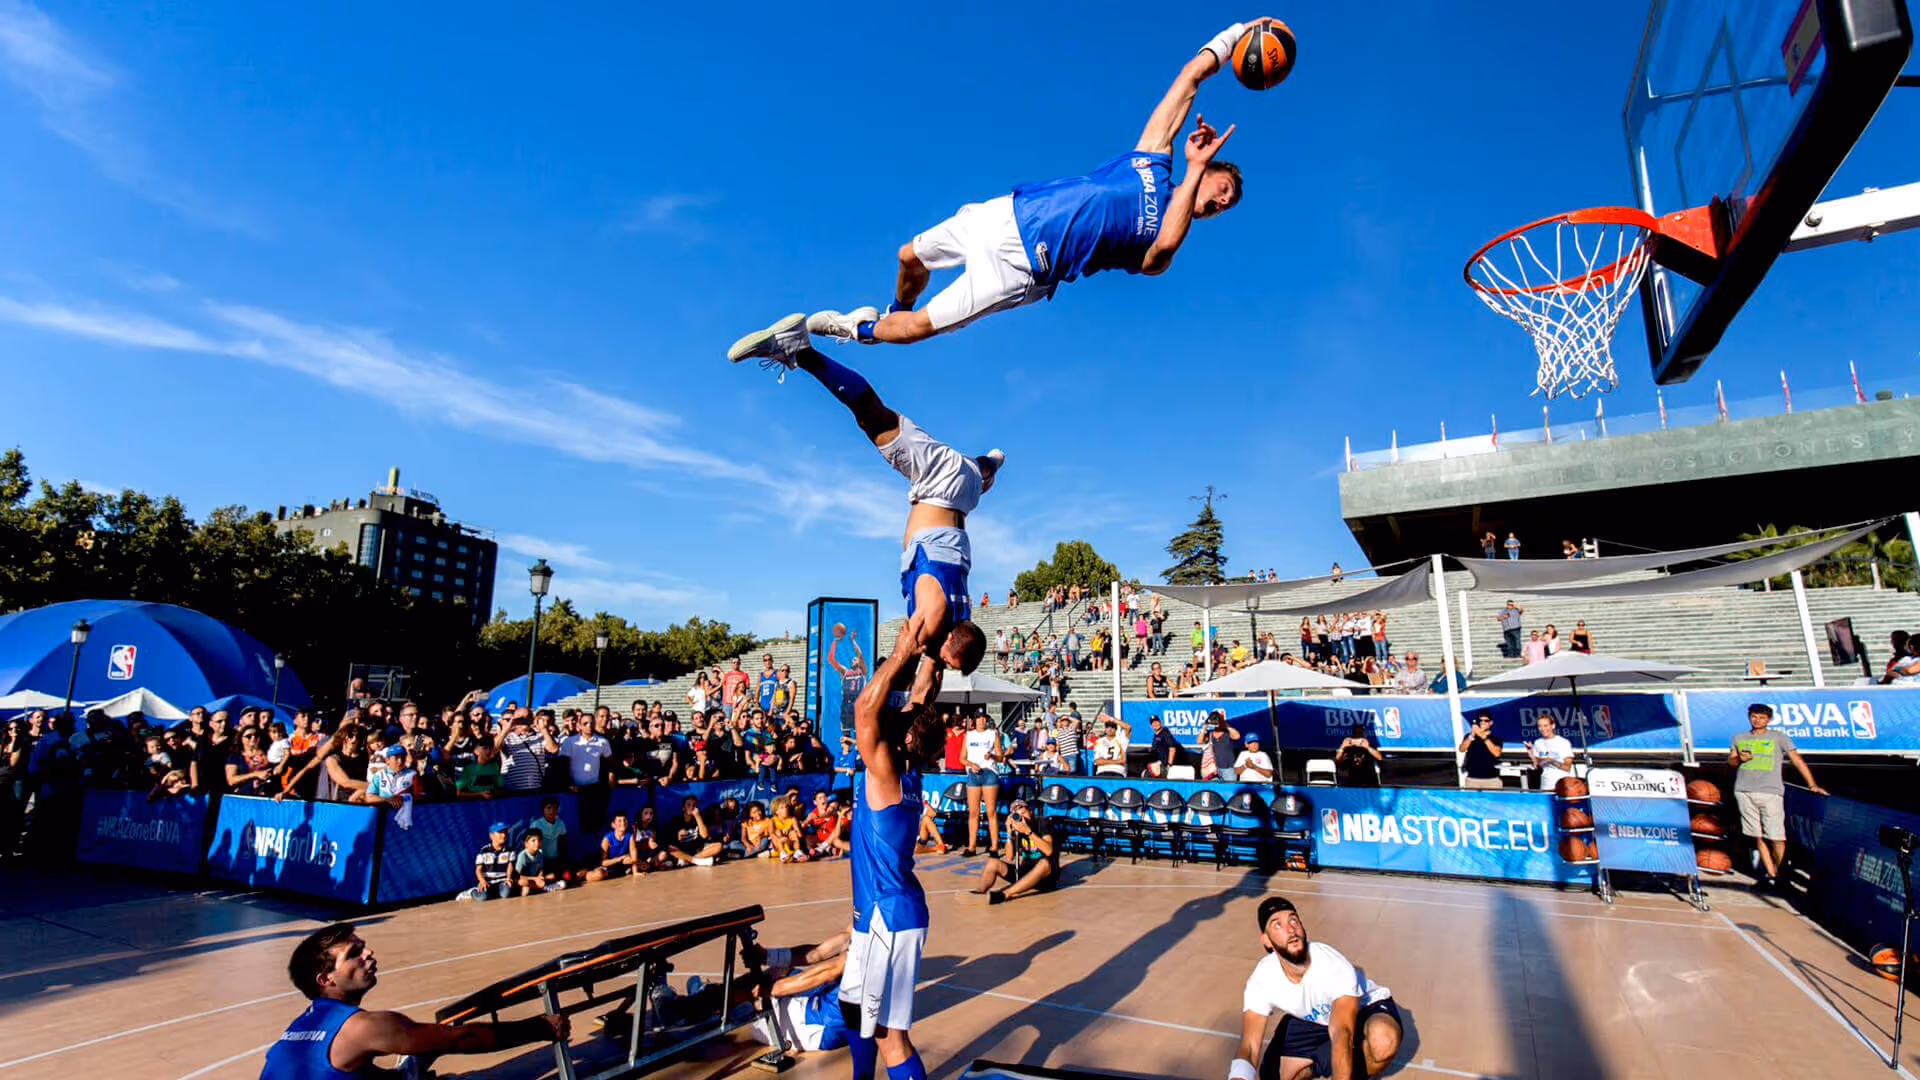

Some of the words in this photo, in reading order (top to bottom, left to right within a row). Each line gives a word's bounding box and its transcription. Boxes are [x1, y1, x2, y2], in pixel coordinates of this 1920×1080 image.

[1325, 708, 1383, 727] BBVA
[1812, 727, 1850, 738] Bank
[1611, 780, 1666, 793] SPALDING
